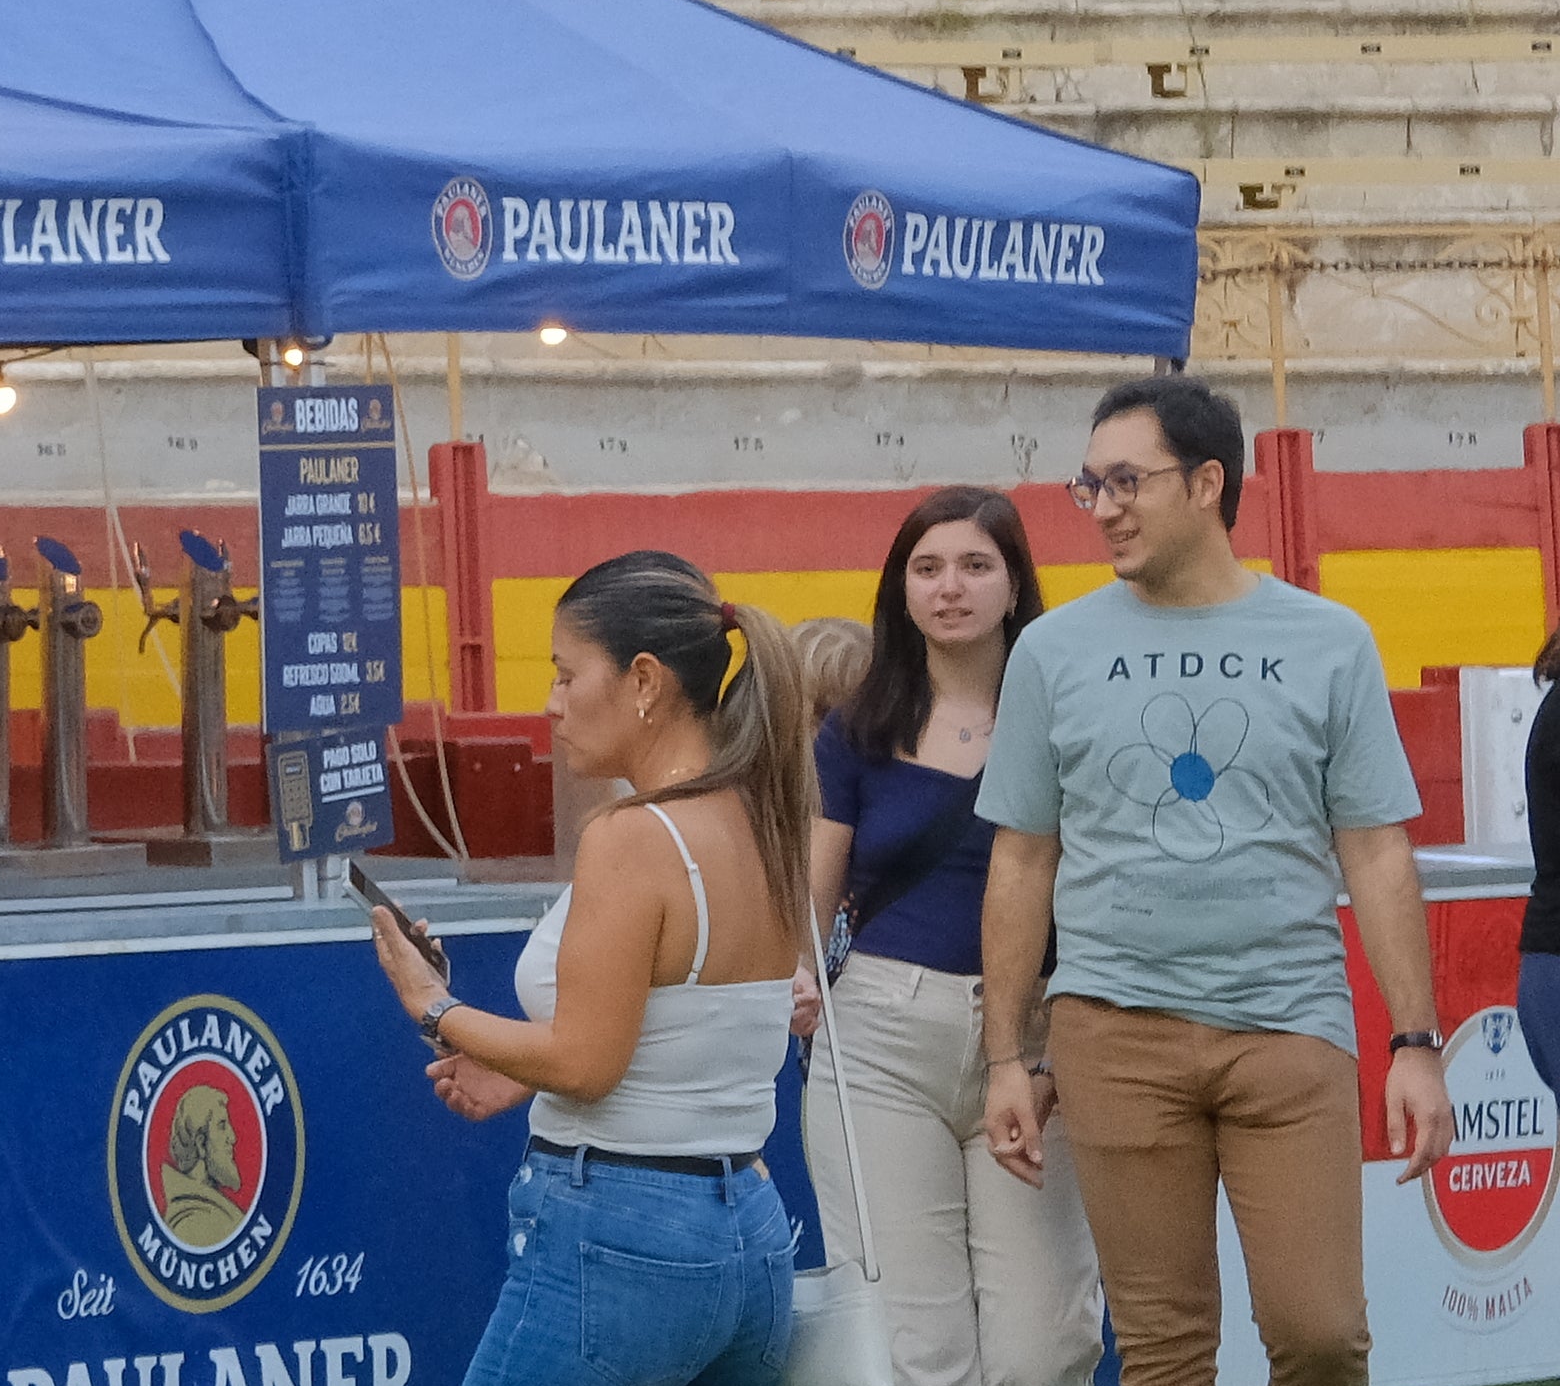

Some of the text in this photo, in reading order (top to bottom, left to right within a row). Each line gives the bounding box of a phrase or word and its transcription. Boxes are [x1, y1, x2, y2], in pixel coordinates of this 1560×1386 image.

[502, 197, 740, 264] PAULANER
[901, 212, 1105, 286] PAULANER
[295, 397, 359, 433] BEBIDAS
[299, 457, 360, 485] PAULANER
[1107, 652, 1285, 684] ATDCK
[351, 740, 377, 764] SOLO
[122, 1014, 286, 1126] PAULANER
[1449, 1160, 1532, 1193] CERVEZA
[137, 1212, 273, 1291] MÜNCHEN
[57, 1269, 117, 1320] Seit
[296, 1252, 366, 1297] 1634
[1442, 1277, 1533, 1321] 100% MALTA
